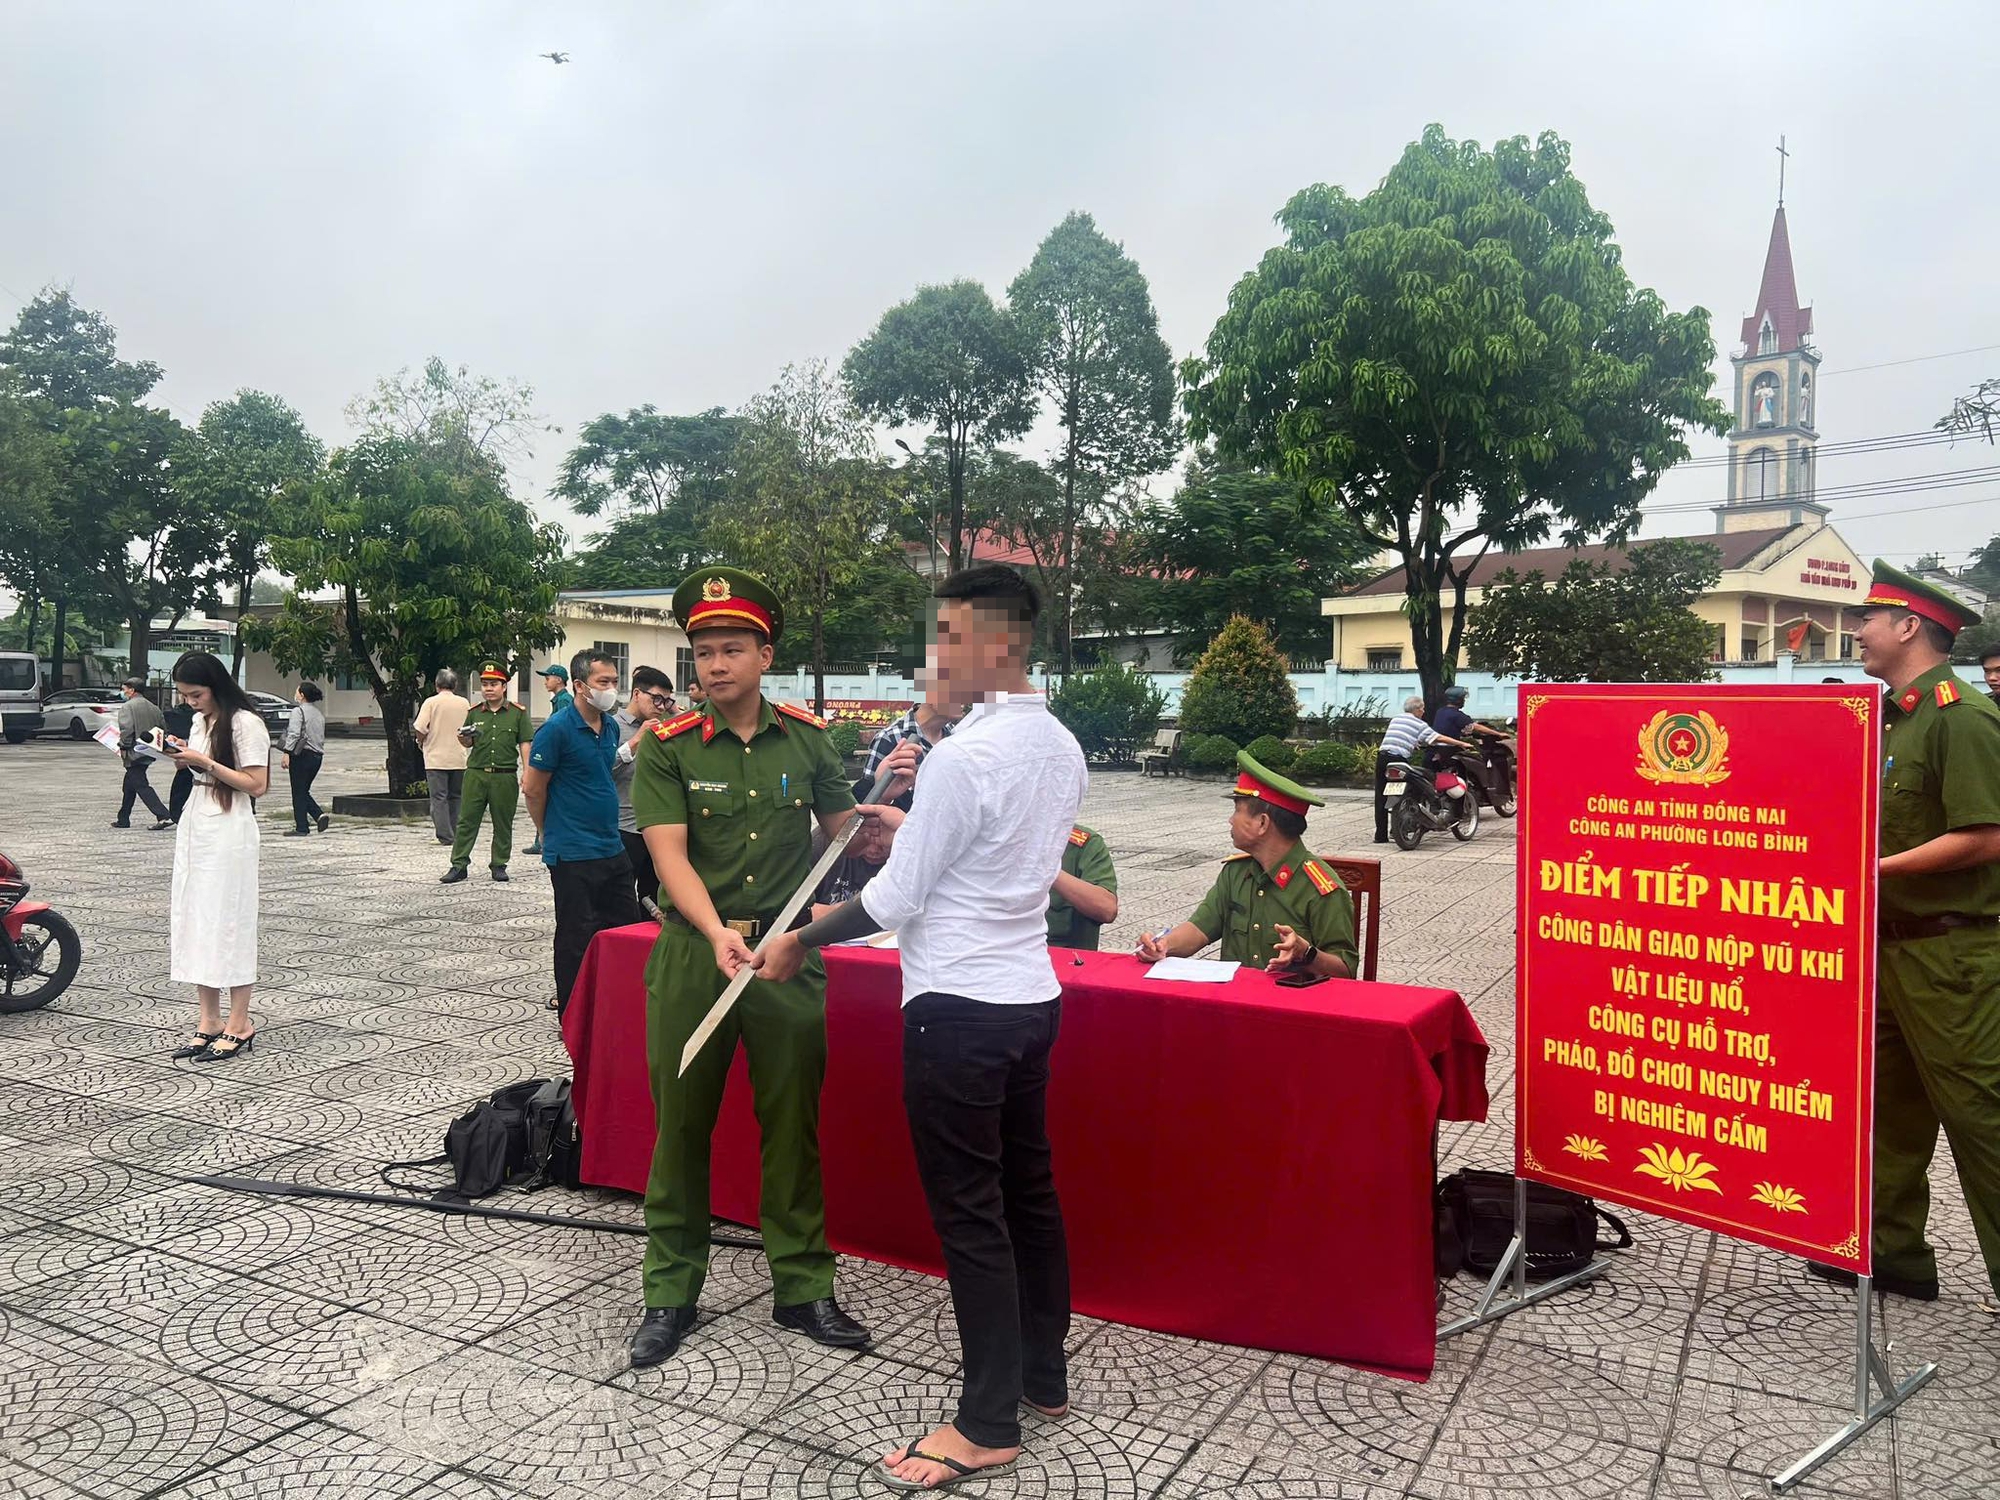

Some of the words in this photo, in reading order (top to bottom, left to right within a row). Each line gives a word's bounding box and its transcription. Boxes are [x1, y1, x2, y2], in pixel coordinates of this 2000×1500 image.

[1569, 816, 1611, 837] CÔNG
[1615, 822, 1636, 839] AN
[1641, 823, 1708, 845] PHƯỜNG
[1713, 829, 1758, 849] LONG
[1764, 831, 1808, 853] BÌNH
[1587, 794, 1629, 815] CÔNG
[1634, 799, 1655, 817] AN
[1660, 797, 1698, 820] TỈNH
[1703, 799, 1750, 823] ĐỒNG
[1756, 807, 1786, 826] NAI
[1540, 849, 1621, 900] ĐIỂM
[1632, 862, 1709, 909] TIẾP
[1719, 876, 1845, 929] NHẬN
[1538, 912, 1593, 946] CÔNG
[1598, 919, 1642, 953] DÂN
[1648, 929, 1699, 960] GIAO
[1706, 933, 1755, 969] NỘP
[1762, 941, 1793, 974] VŨ
[1800, 947, 1844, 981] KHÍ
[1611, 963, 1650, 1000] VẬT
[1655, 971, 1704, 1008] LIỆU
[1710, 975, 1750, 1017] NỔ,
[1588, 1003, 1645, 1039] CÔNG
[1651, 1016, 1681, 1052] CỤ
[1687, 1016, 1718, 1052] HỖ
[1724, 1028, 1777, 1068] TRỢ,
[1544, 1037, 1602, 1076] PHÁO,
[1607, 1046, 1635, 1079] ĐỒ
[1641, 1057, 1693, 1092] CHƠI
[1699, 1068, 1763, 1106] NGUY
[1769, 1079, 1833, 1122] HIỂM
[1594, 1089, 1616, 1124] BỊ
[1621, 1095, 1707, 1139] NGHIÊM
[1713, 1113, 1767, 1154] CẤM
